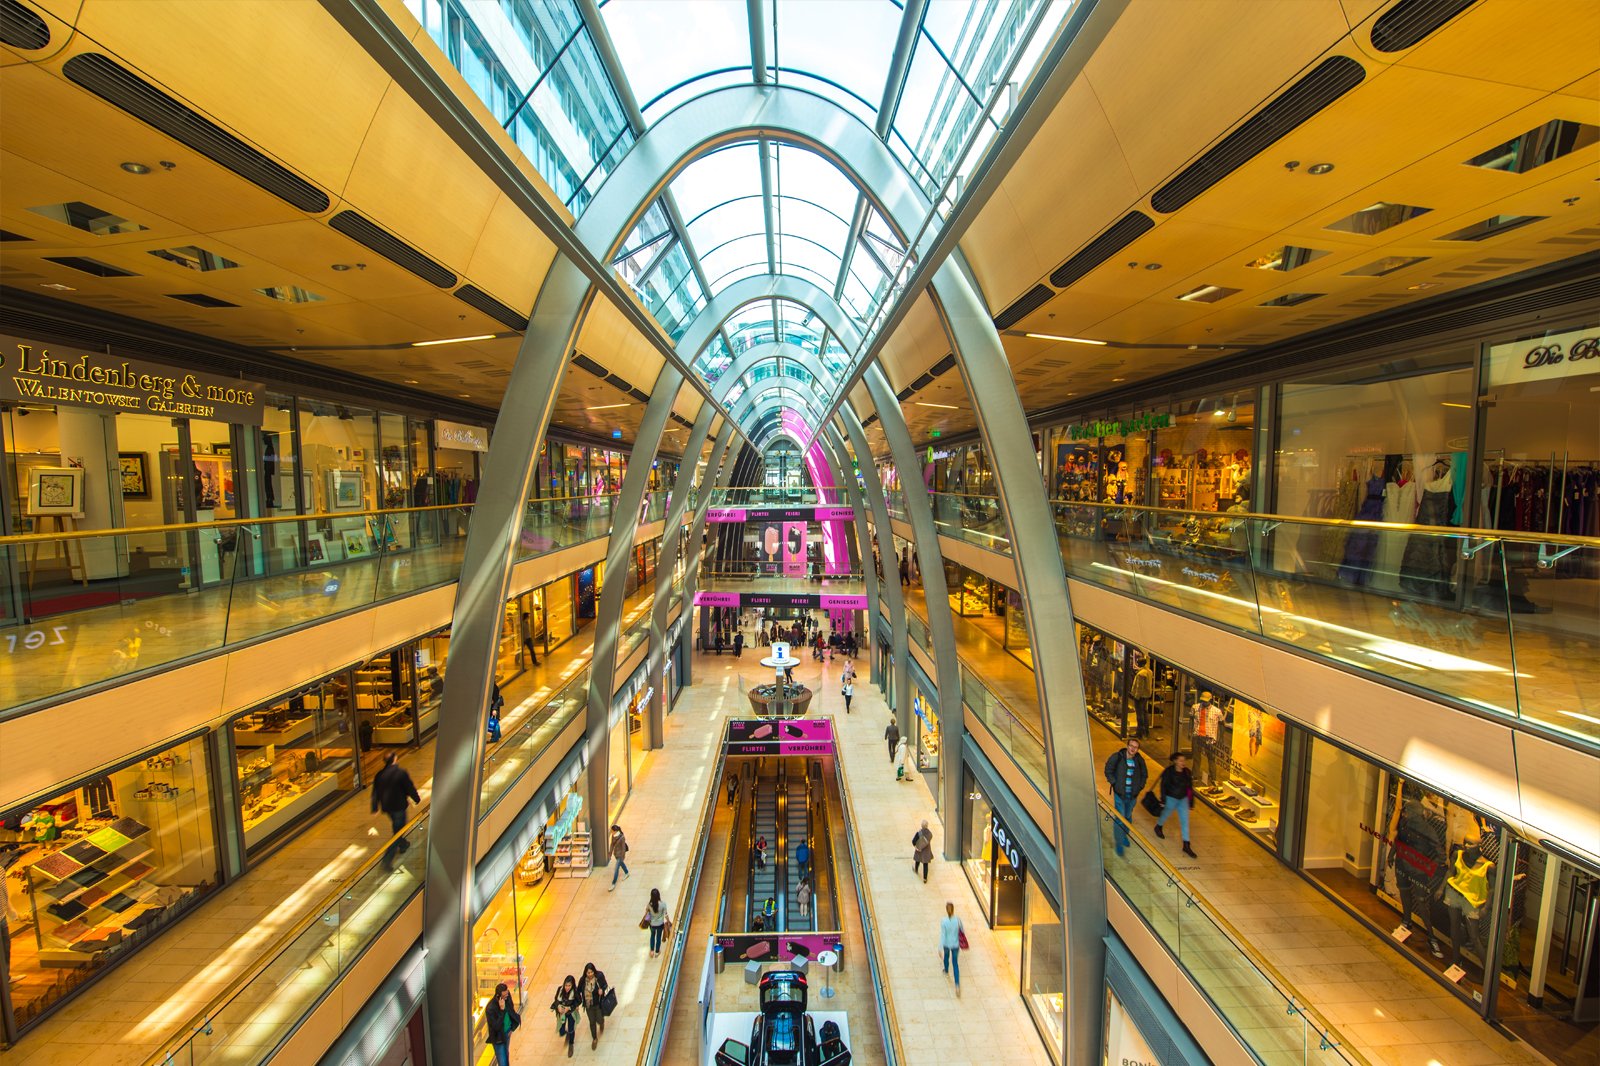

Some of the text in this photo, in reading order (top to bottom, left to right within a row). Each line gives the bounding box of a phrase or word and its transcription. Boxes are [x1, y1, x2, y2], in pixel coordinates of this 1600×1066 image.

[17, 344, 176, 399] Lindenberg
[181, 374, 201, 398] &
[206, 384, 255, 406] more
[1523, 344, 1564, 369] Die
[147, 395, 214, 417] GALERIEN
[992, 816, 1019, 869] zero
